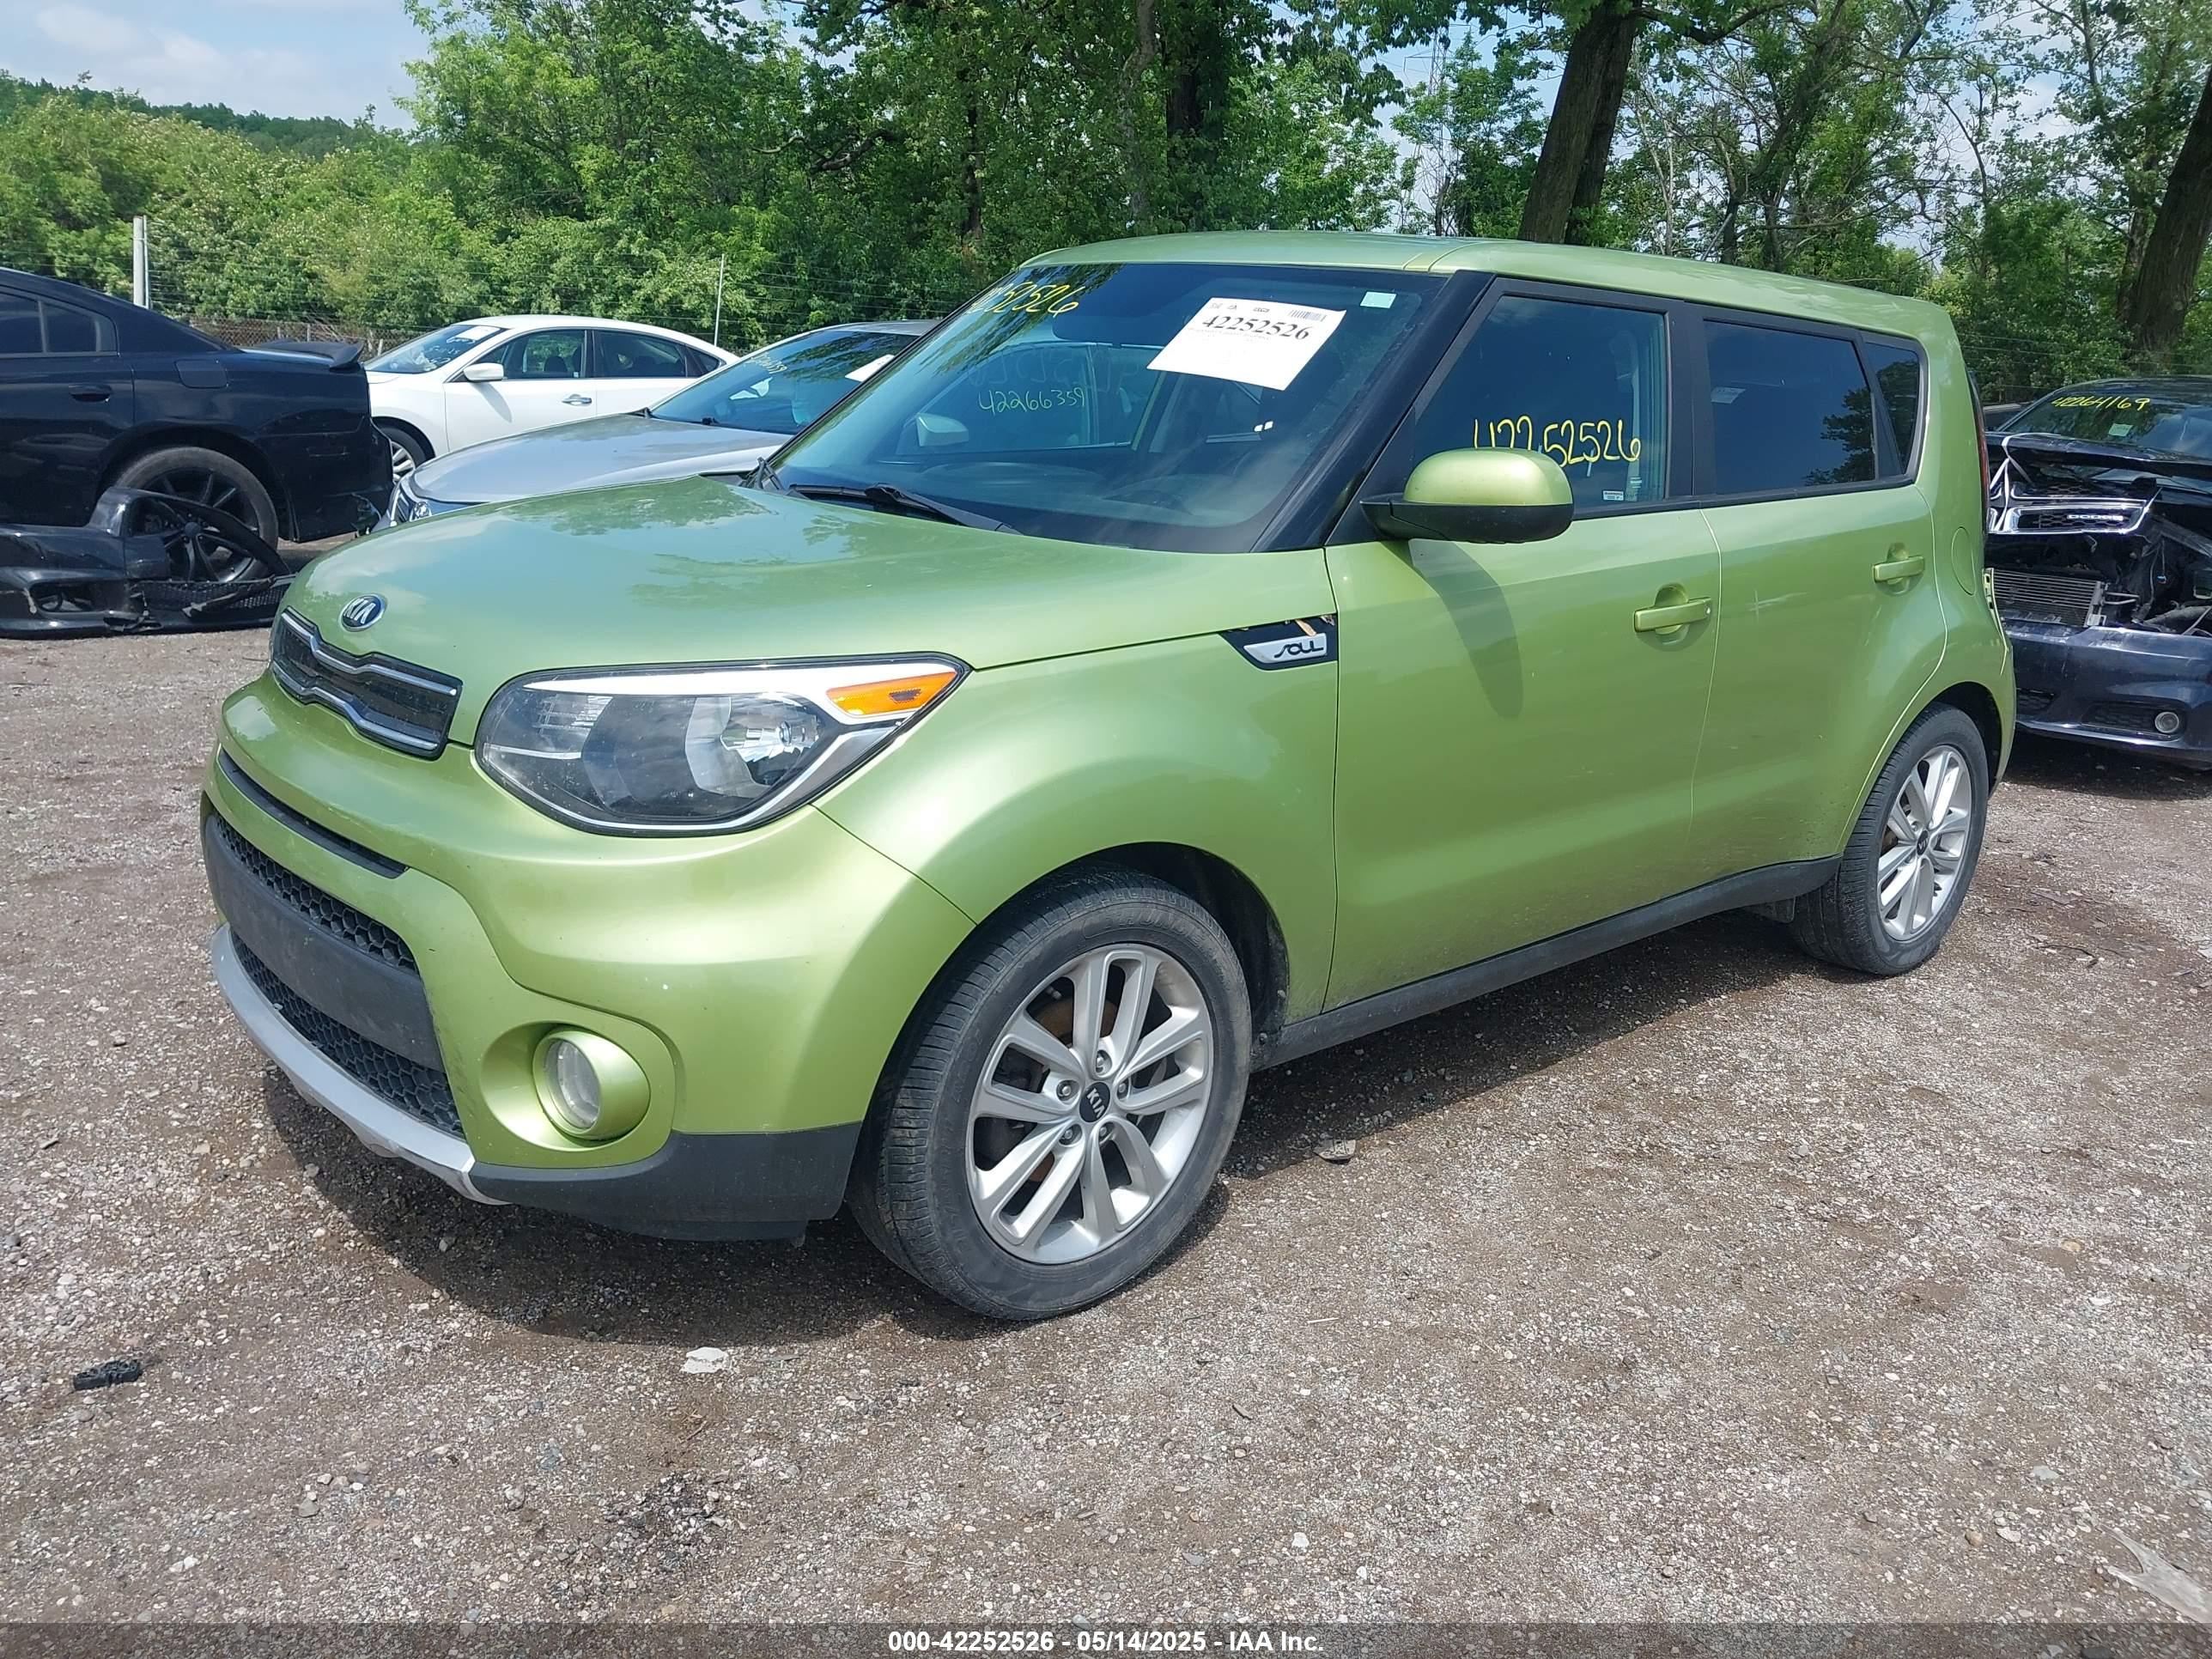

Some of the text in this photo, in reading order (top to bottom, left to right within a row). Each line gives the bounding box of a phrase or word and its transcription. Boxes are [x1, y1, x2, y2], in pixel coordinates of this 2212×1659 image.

[1202, 315, 1313, 340] 42252526
[978, 386, 1085, 416] 42266359
[343, 598, 376, 624] KIA
[1086, 1087, 1105, 1119] KIA
